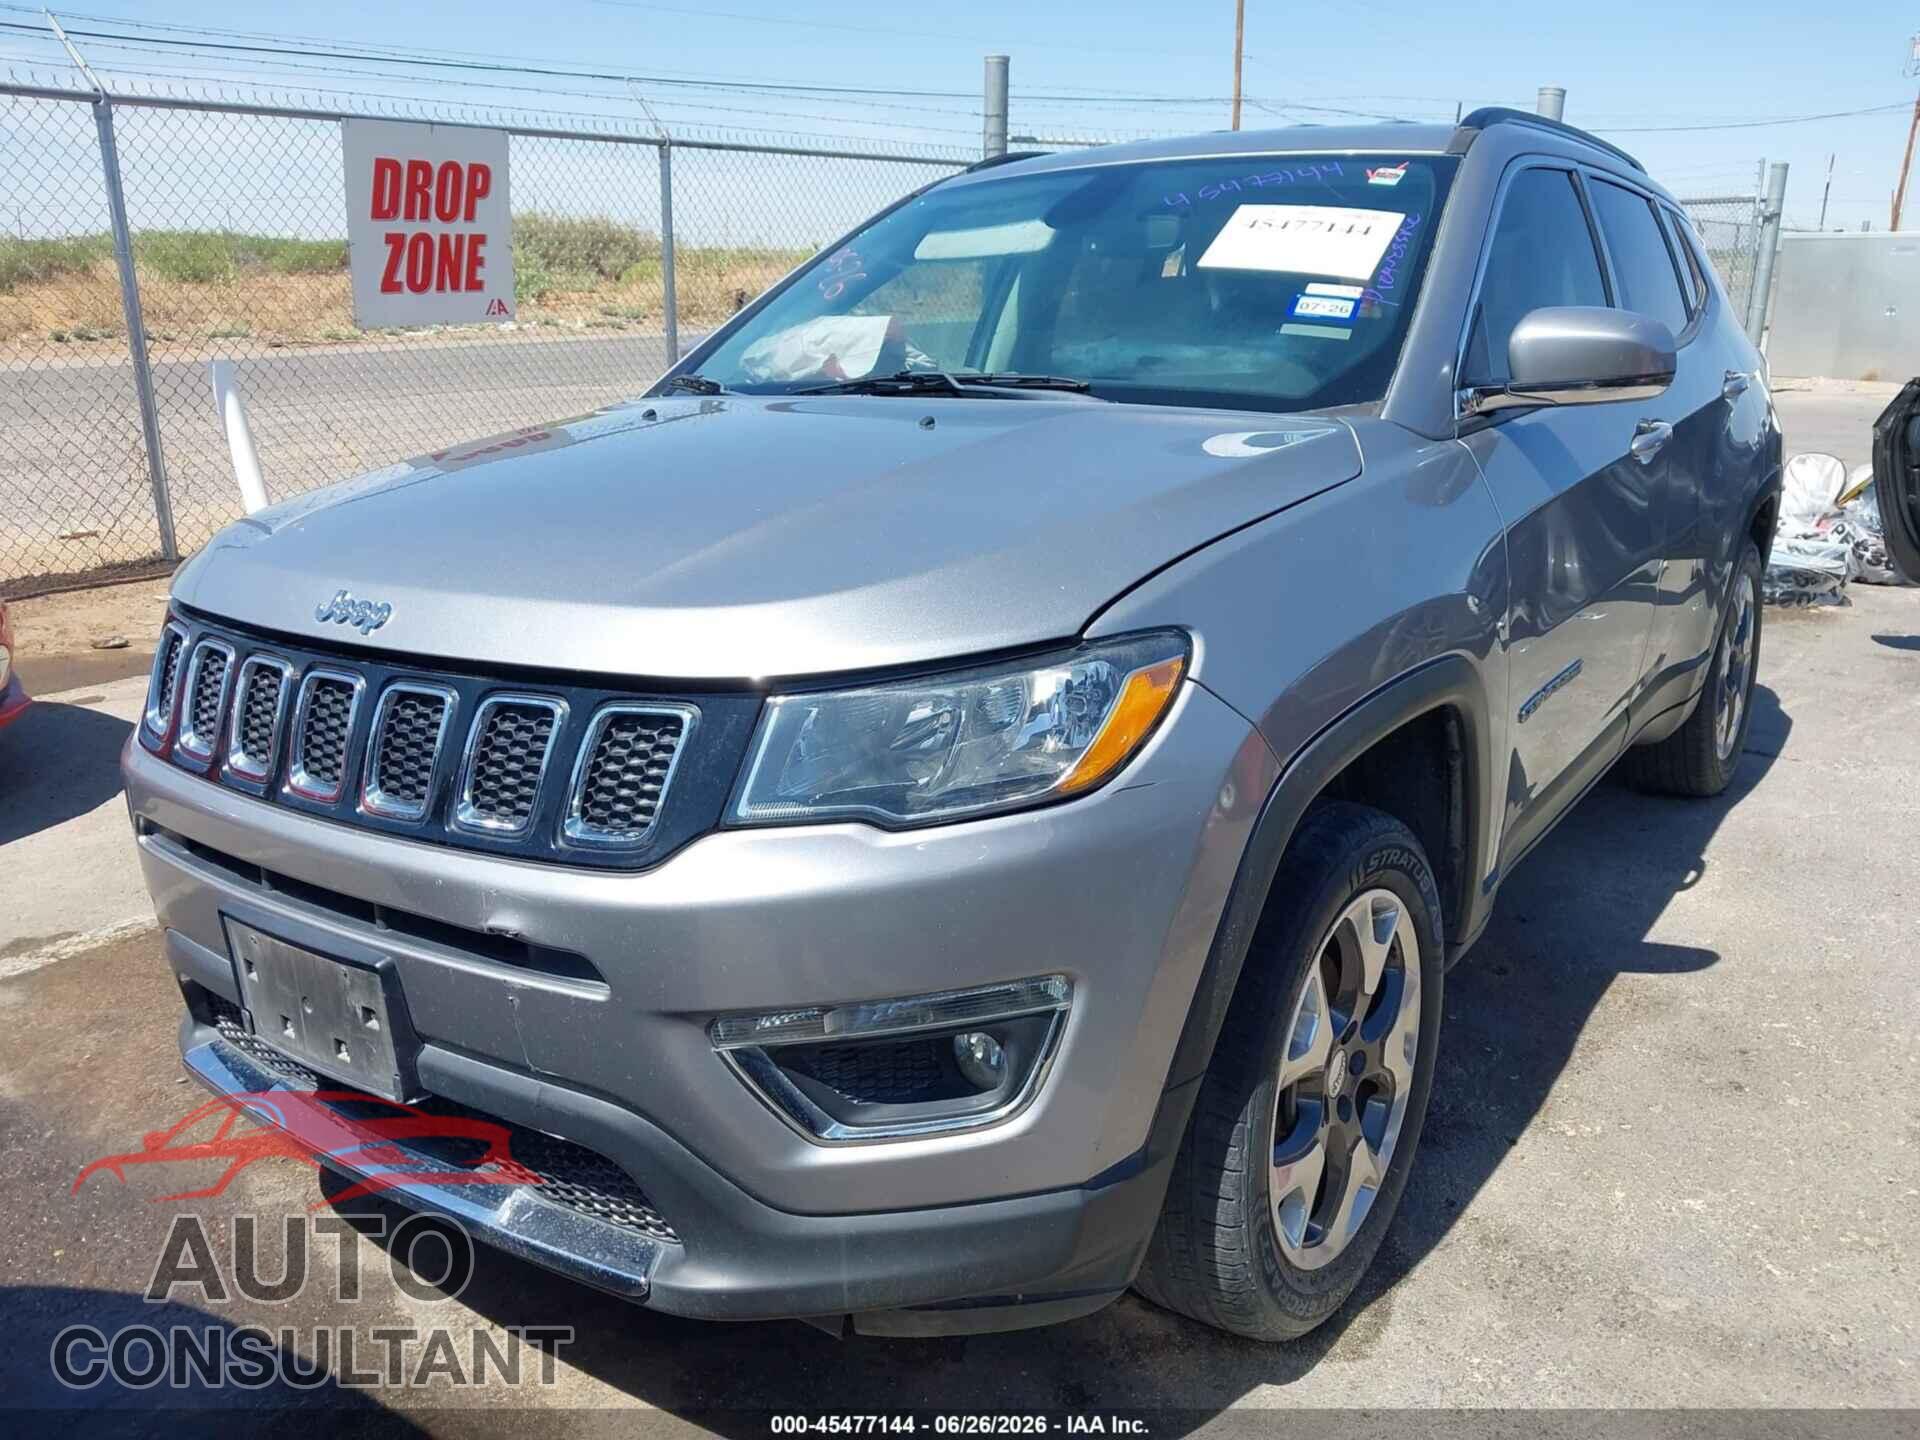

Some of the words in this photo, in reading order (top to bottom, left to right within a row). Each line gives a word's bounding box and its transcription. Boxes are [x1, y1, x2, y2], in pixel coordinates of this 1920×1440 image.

[371, 157, 491, 223] DROP
[380, 232, 487, 295] ZONE
[316, 589, 392, 635] Jeep
[1366, 848, 1432, 892] STRATUS
